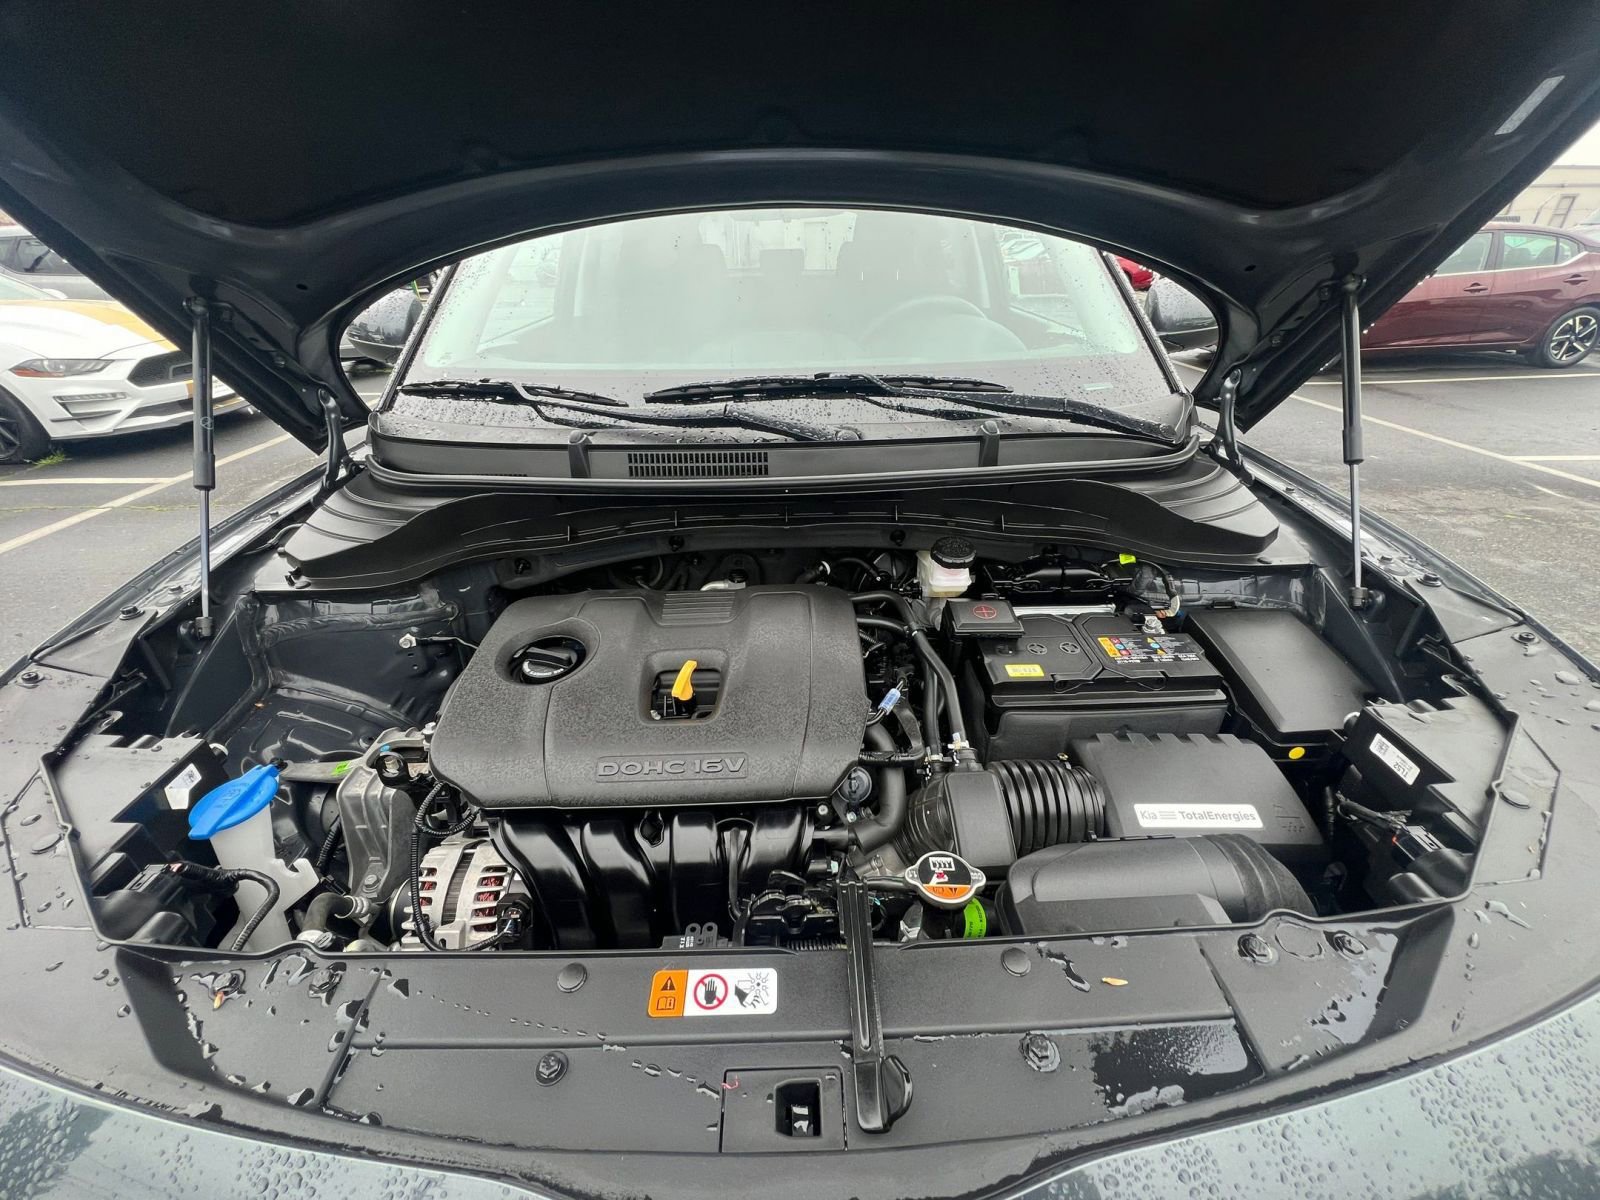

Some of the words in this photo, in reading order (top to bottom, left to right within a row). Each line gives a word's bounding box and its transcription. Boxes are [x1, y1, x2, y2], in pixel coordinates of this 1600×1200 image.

[597, 760, 687, 777] DOHC
[694, 757, 746, 774] 16V
[1139, 810, 1158, 820] Kia
[1179, 810, 1257, 822] TotalEnergies
